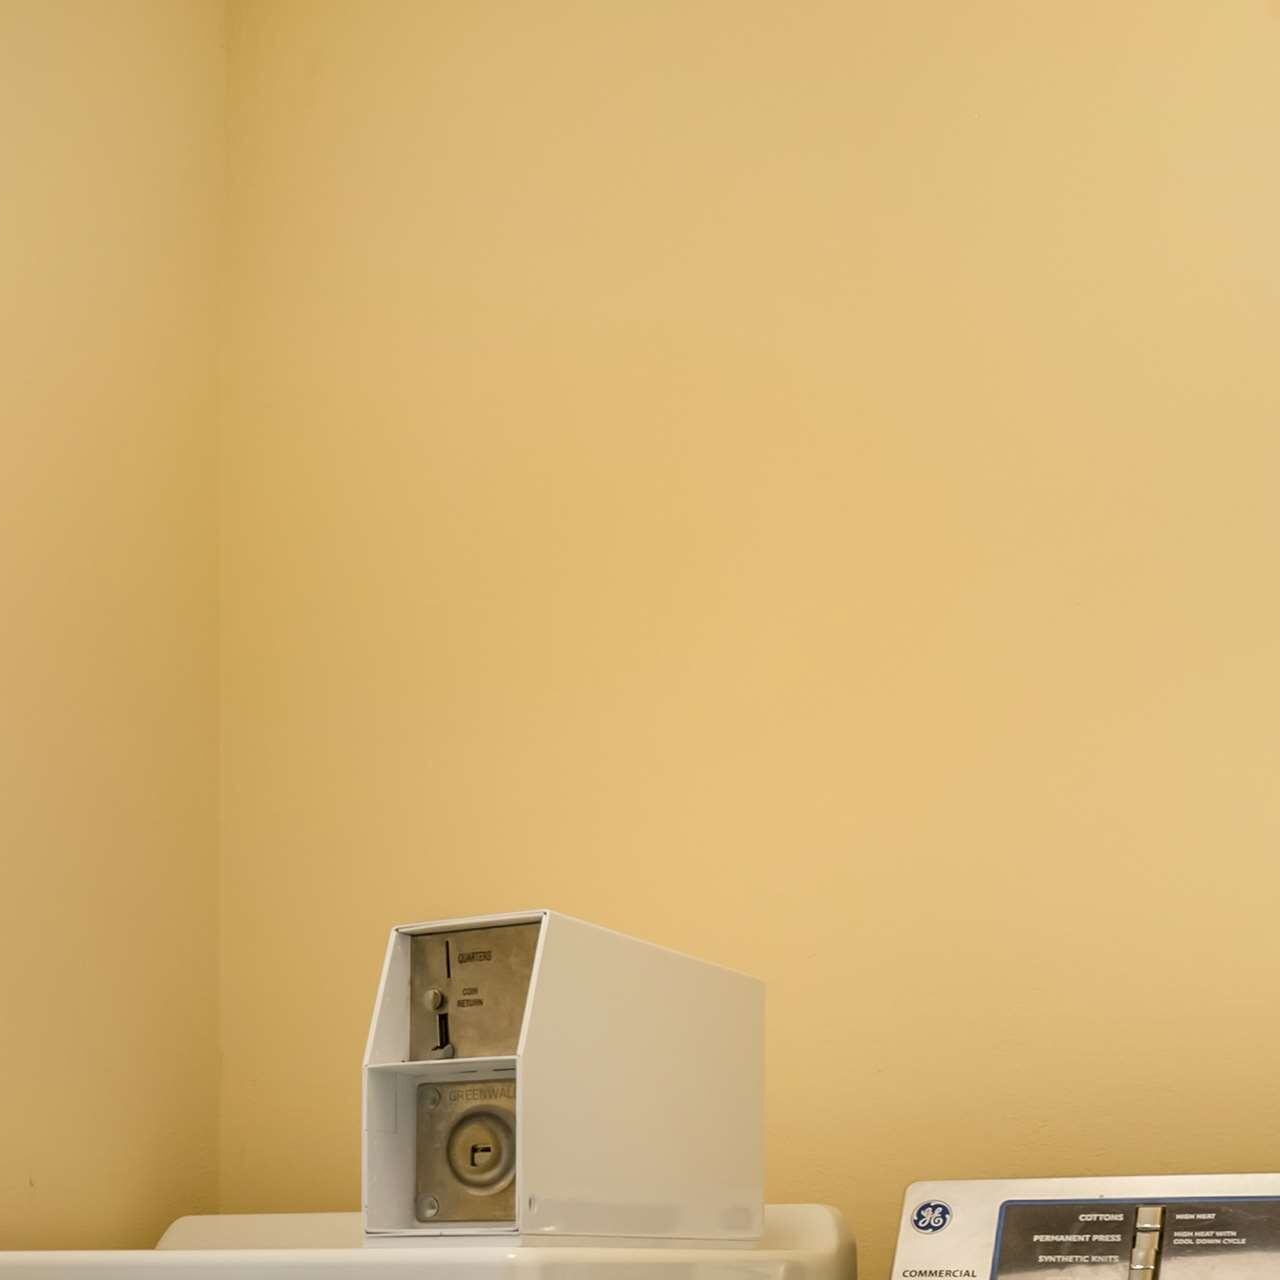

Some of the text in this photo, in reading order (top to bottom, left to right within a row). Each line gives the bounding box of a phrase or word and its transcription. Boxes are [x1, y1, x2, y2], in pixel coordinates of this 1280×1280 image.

[449, 1086, 516, 1102] GREENWAL
[1079, 1213, 1124, 1221] COTTONS
[1032, 1234, 1122, 1242] PERMANENT PRESS
[1038, 1254, 1120, 1263] SYNTHETIC KNITS
[901, 1269, 977, 1278] COMMERCIAL
